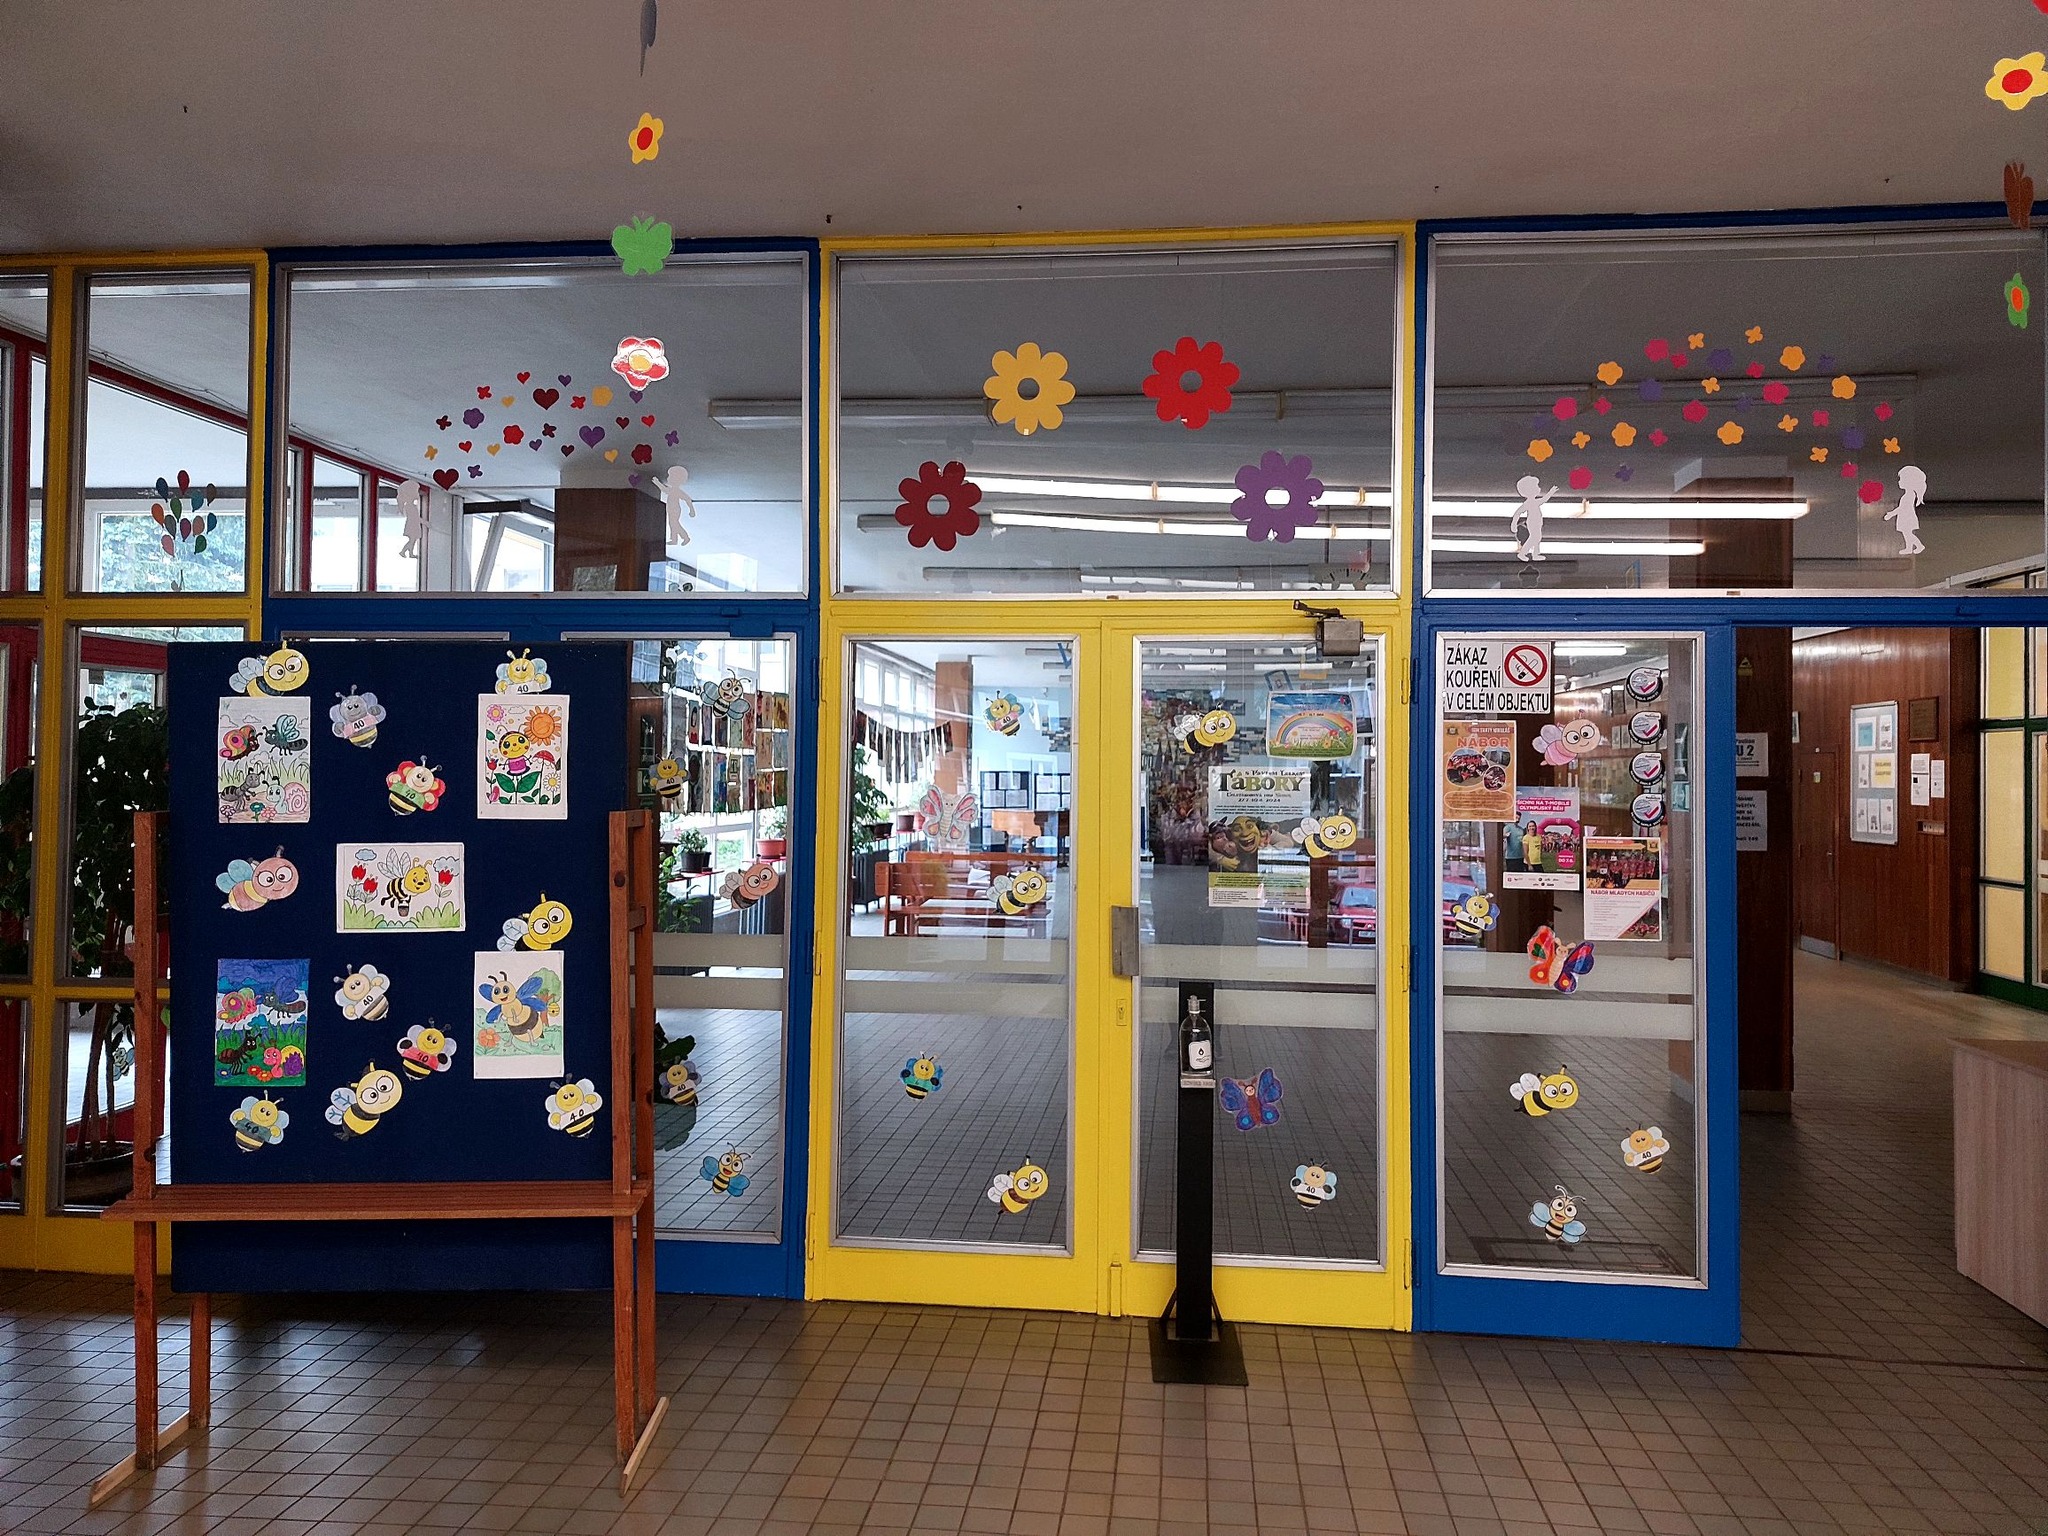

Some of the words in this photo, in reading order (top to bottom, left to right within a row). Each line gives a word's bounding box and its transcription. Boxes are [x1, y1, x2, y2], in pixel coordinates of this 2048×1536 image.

[1447, 643, 1488, 665] ZÁKAZ
[1446, 666, 1501, 688] KOUŘENÍ
[517, 684, 529, 693] 40
[1446, 692, 1454, 710] V
[1457, 688, 1495, 711] CELÉM
[1498, 693, 1549, 711] OBJEKTU
[353, 719, 365, 730] 40
[1002, 716, 1011, 724] 40
[1746, 744, 1754, 756] 2
[405, 789, 416, 800] 40
[1467, 915, 1479, 924] 40
[363, 995, 374, 1006] 40
[677, 1083, 686, 1091] 40
[569, 1109, 585, 1122] 40
[1642, 1151, 1652, 1159] 40
[1306, 1186, 1316, 1194] 40
